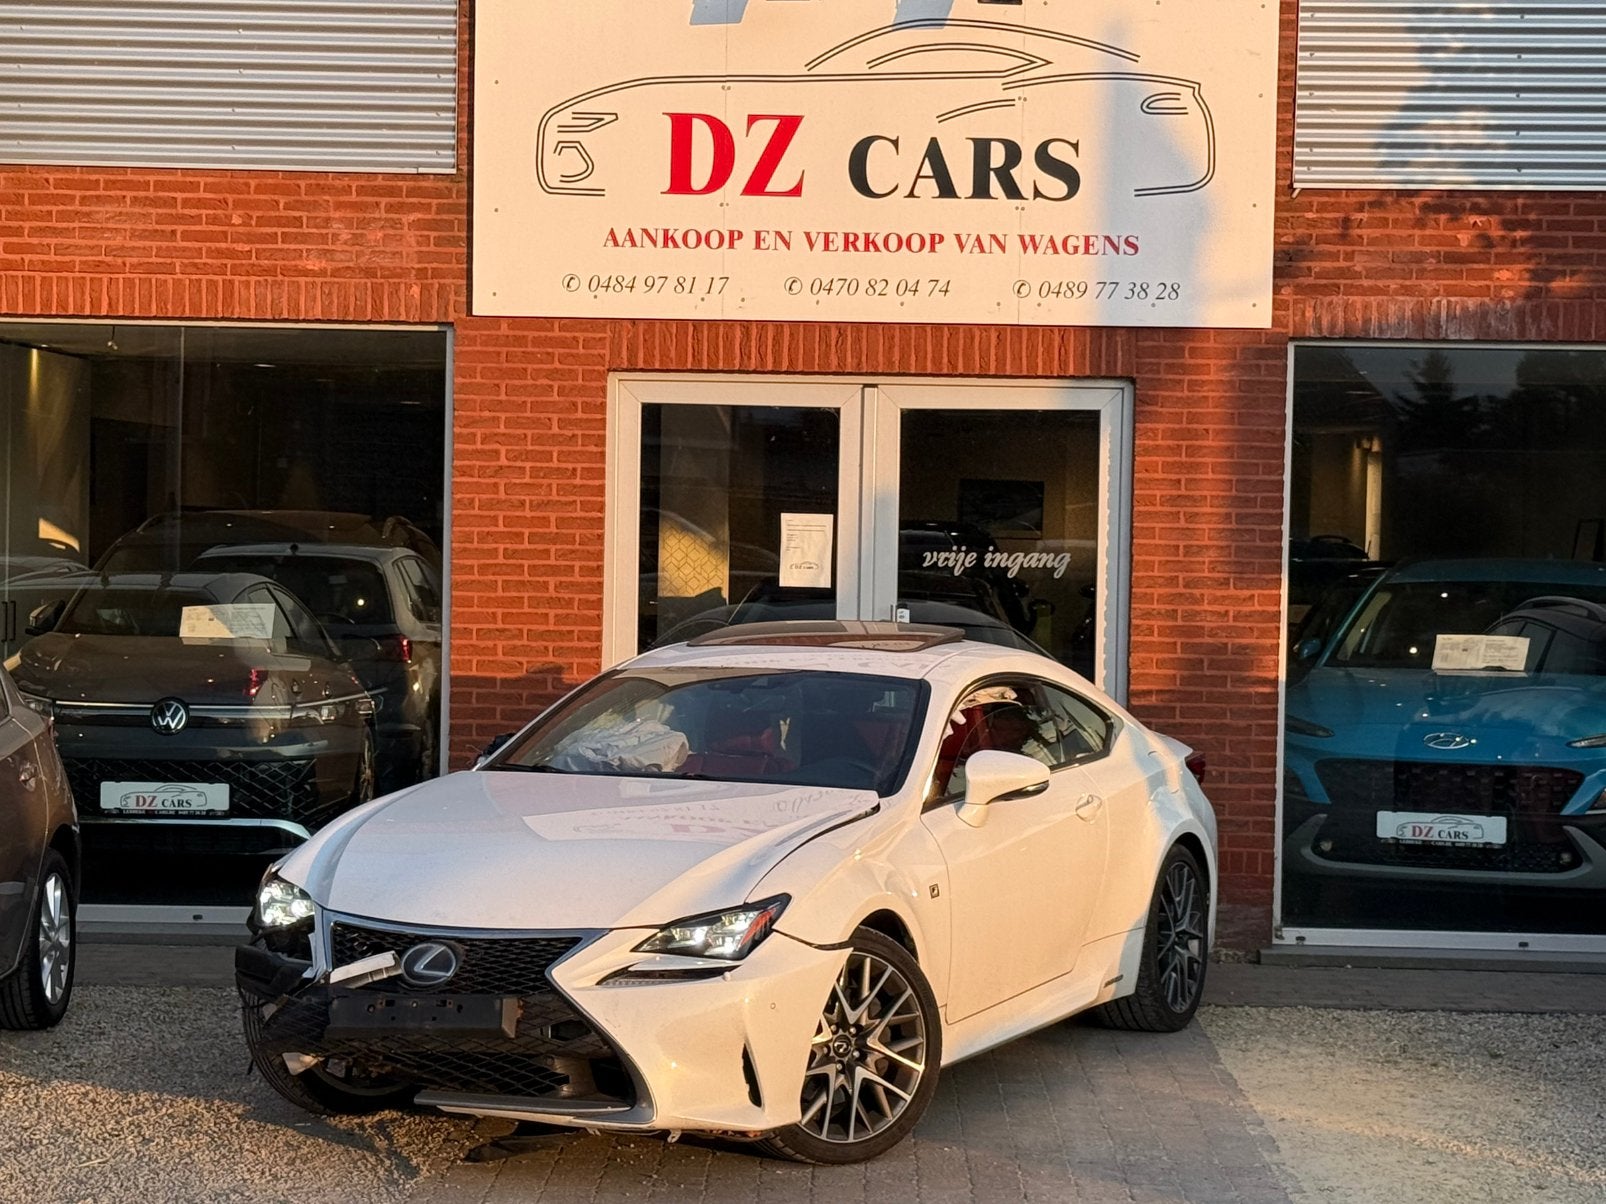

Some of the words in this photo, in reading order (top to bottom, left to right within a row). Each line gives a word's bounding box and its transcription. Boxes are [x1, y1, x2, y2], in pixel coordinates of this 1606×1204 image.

[662, 112, 805, 197] DZ
[849, 135, 1081, 202] CARS
[603, 227, 744, 250] AANKOOP
[753, 229, 793, 251] EN
[803, 230, 945, 254] VERKOOP
[953, 233, 1008, 255] VAN
[1017, 234, 1140, 257] WAGENS
[588, 274, 637, 293] 0484
[643, 275, 669, 294] 97
[673, 276, 697, 295] 81
[704, 276, 730, 295] 17
[809, 277, 860, 296] 0470
[864, 278, 889, 297] 82
[895, 278, 921, 297] 04
[927, 278, 951, 298] 74
[1036, 280, 1089, 299] 0489
[1095, 281, 1120, 300] 77
[1124, 281, 1151, 301] 38
[1155, 282, 1181, 301] 28
[922, 545, 977, 577] vrije
[983, 545, 1072, 579] ingang
[136, 795, 158, 808] DZ
[162, 799, 192, 808] CARS
[1412, 826, 1434, 838] DZ
[1438, 830, 1469, 840] CARS
